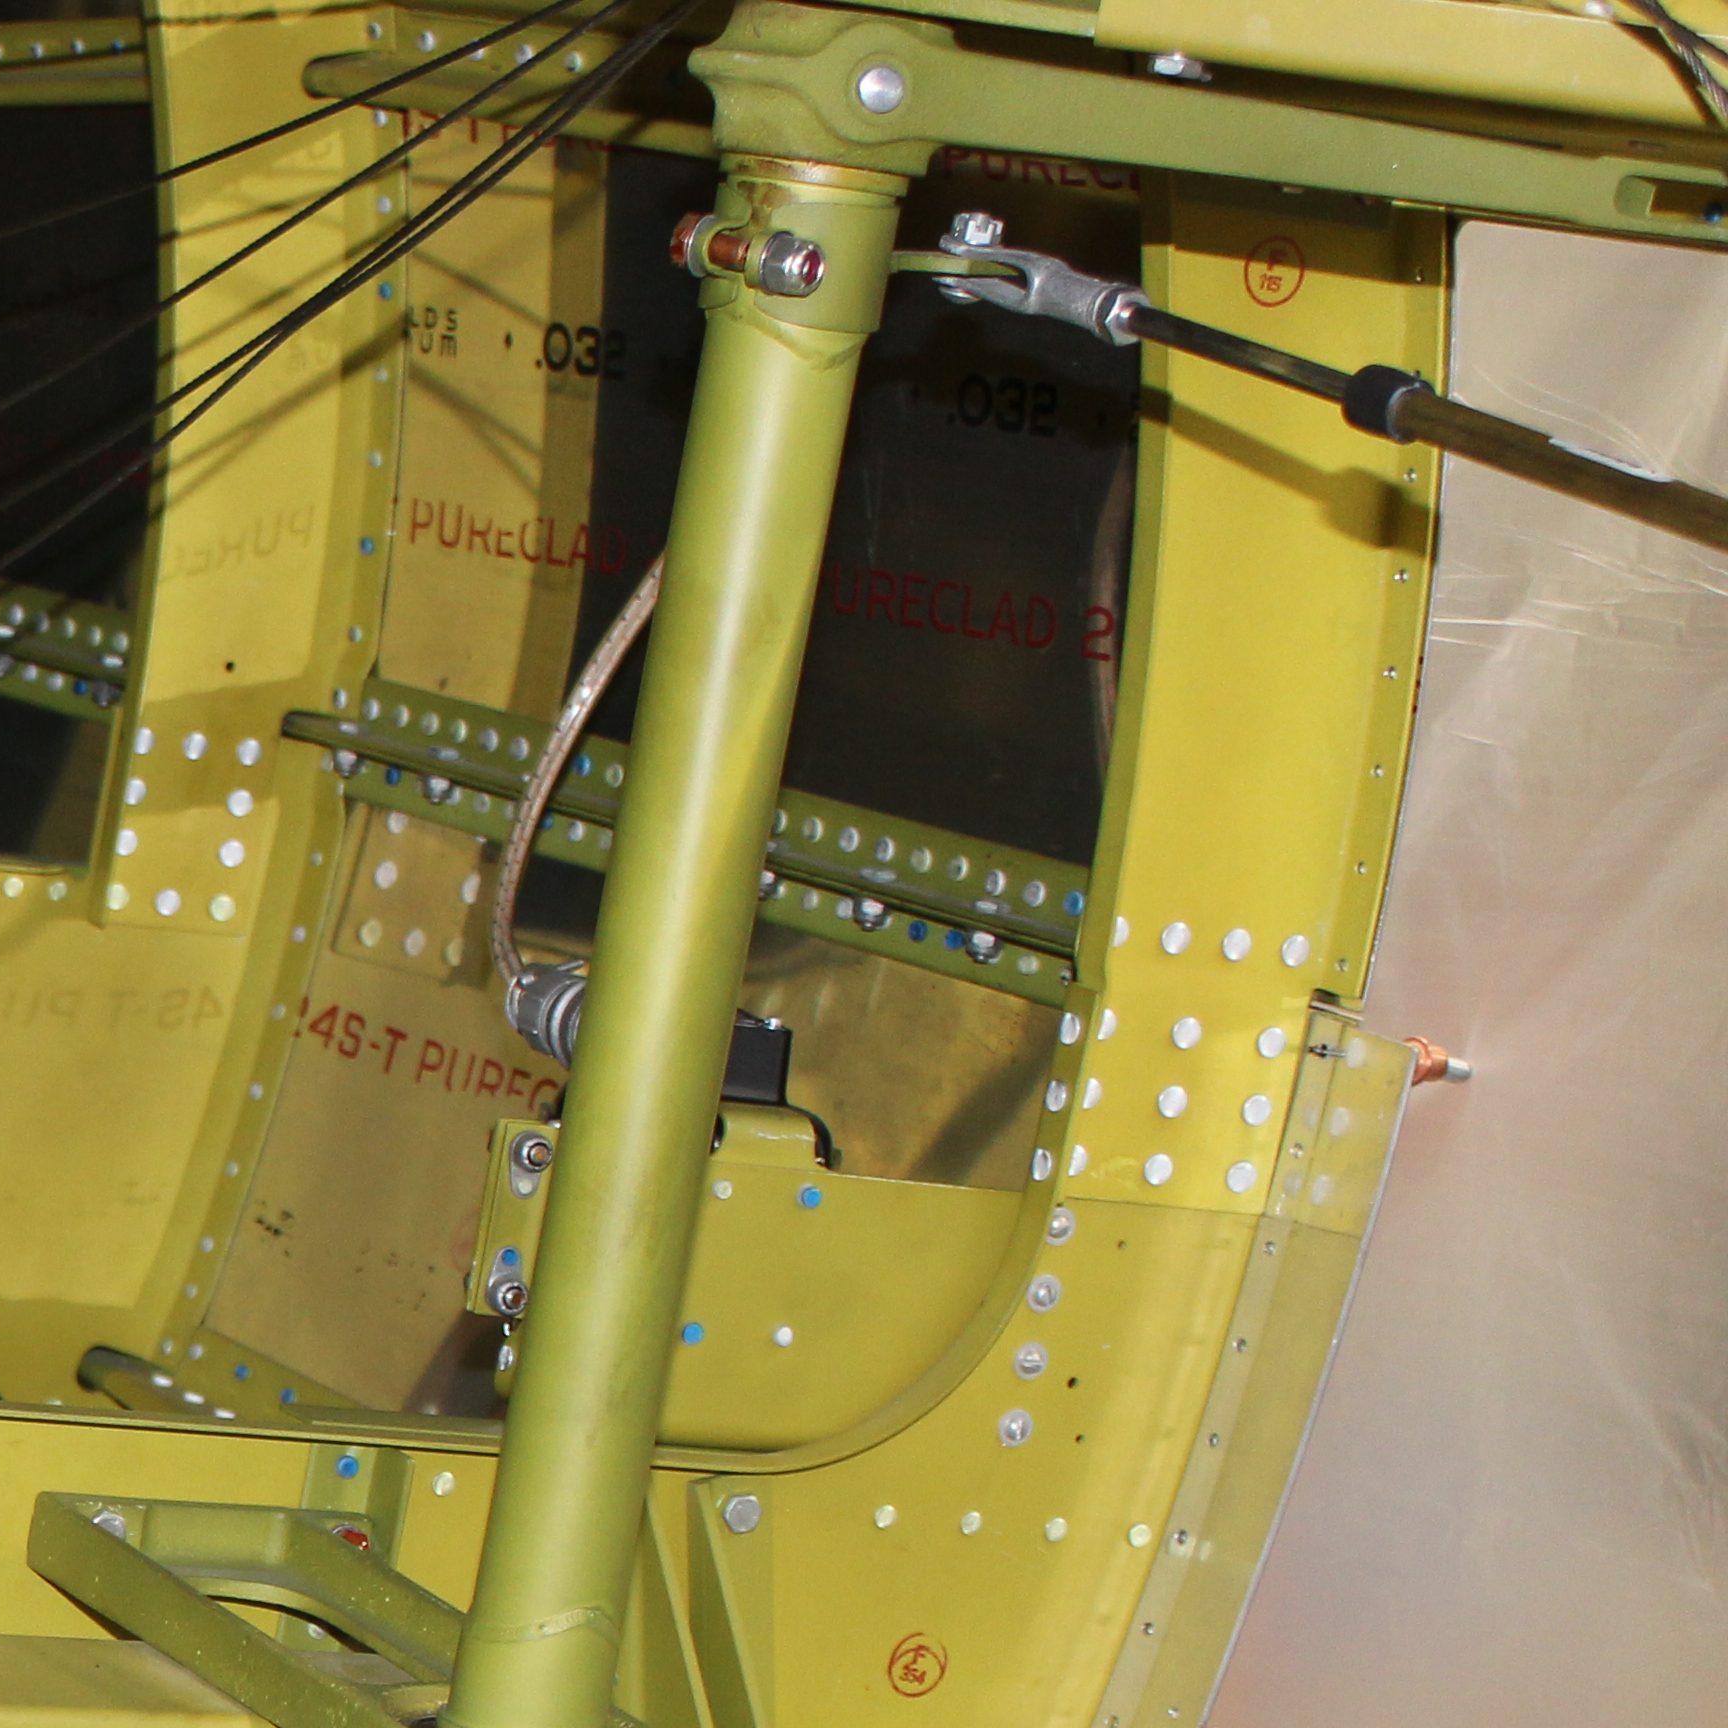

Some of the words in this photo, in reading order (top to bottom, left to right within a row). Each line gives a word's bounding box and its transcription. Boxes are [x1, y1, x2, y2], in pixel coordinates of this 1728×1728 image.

[1267, 248, 1289, 271] F
[535, 320, 627, 380] .032
[947, 373, 1058, 437] .032
[411, 498, 626, 576] PURECLAD
[819, 563, 1058, 649] URECLAD
